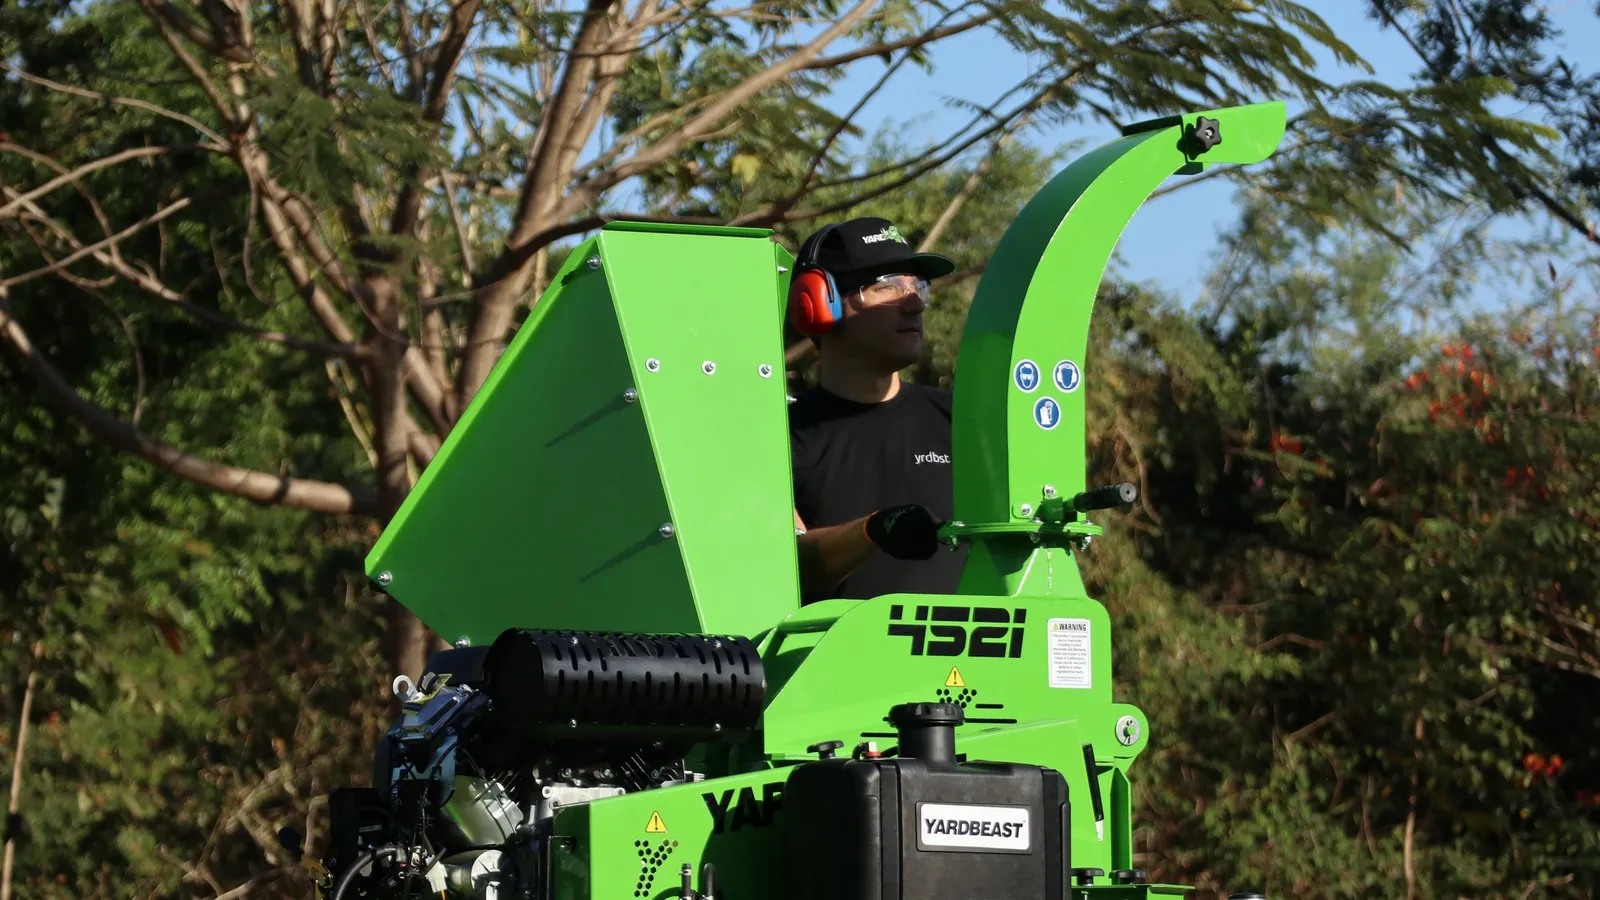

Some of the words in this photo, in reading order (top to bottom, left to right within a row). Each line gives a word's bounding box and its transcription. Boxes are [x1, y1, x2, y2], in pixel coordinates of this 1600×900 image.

[914, 451, 950, 465] yrdbst
[1059, 623, 1087, 631] WARNING
[925, 818, 1023, 838] YARDBEAST
